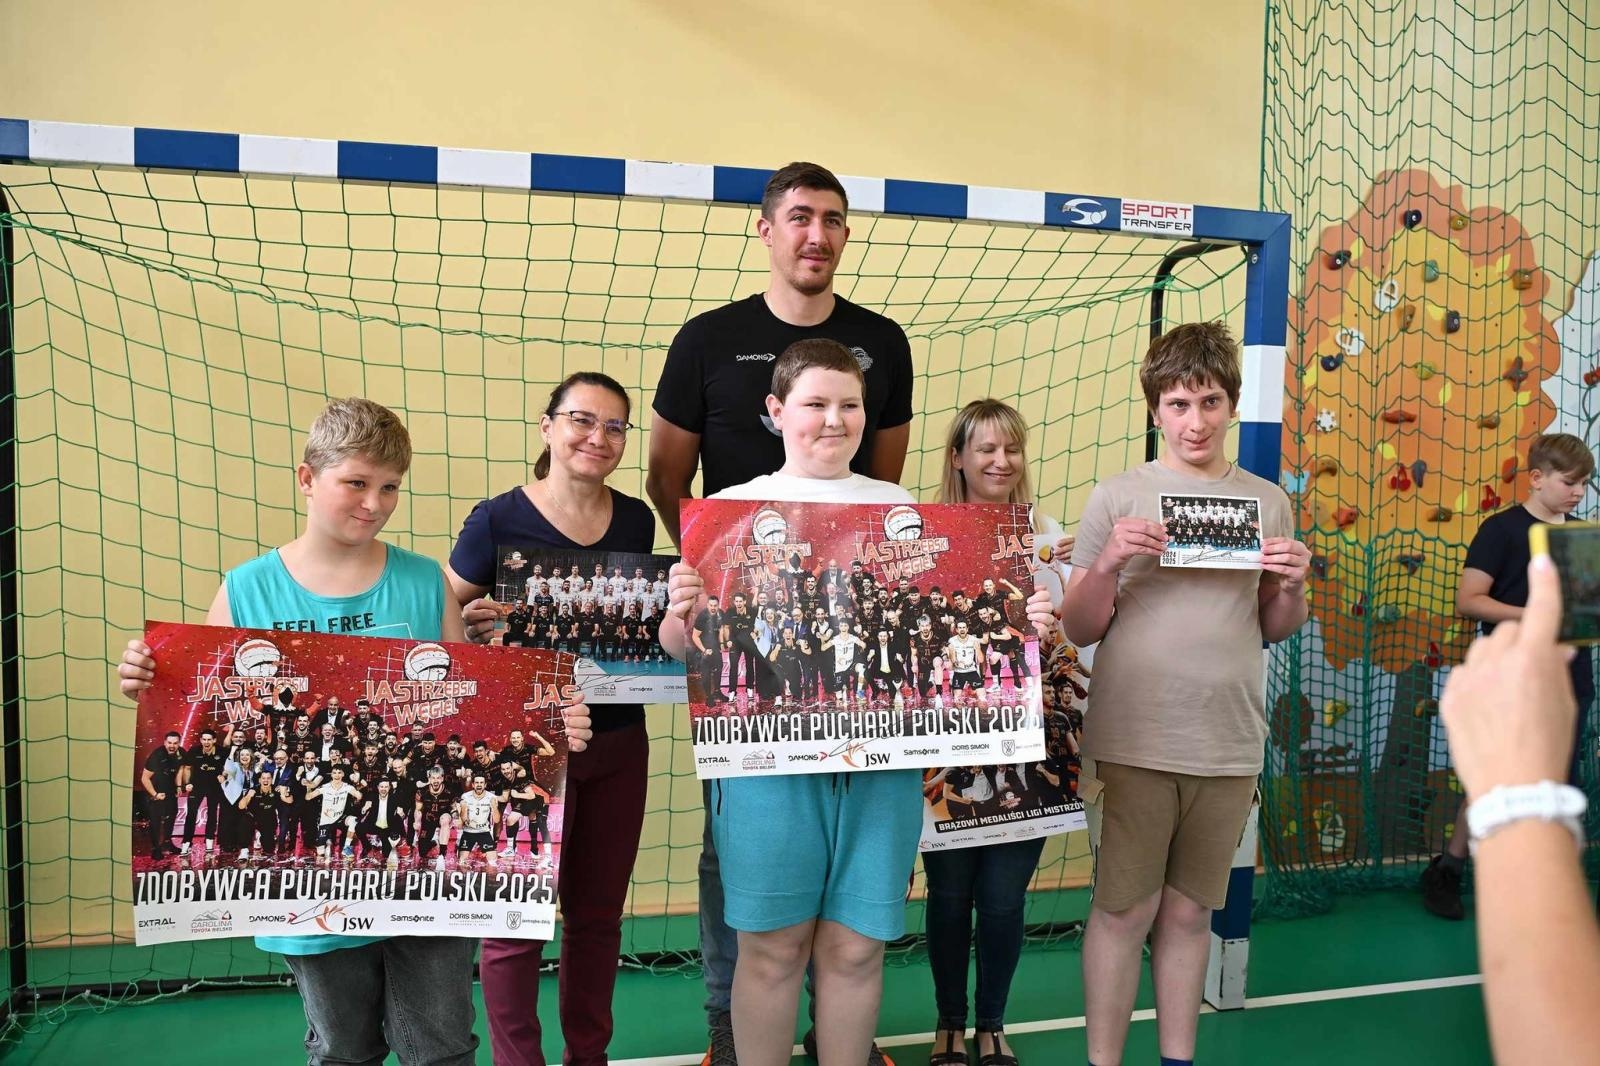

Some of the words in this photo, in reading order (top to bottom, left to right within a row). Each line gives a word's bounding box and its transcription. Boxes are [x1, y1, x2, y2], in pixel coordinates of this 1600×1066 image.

[1122, 203, 1192, 219] SPORT
[1122, 218, 1192, 231] TRANSFER
[736, 353, 769, 362] DAMONS
[328, 612, 376, 633] FREE
[694, 713, 802, 746] ZDOBYWCA
[810, 709, 904, 742] PUCHARU
[912, 707, 980, 736] POLSKI
[788, 754, 819, 762] DAMONS
[903, 747, 940, 756] Samsonite
[698, 756, 730, 764] EXTRAL
[865, 752, 891, 768] JSW
[938, 818, 979, 832] BRĄZOWI
[980, 810, 1025, 826] MEDALIŚCI
[1026, 807, 1042, 818] LIGI
[135, 868, 272, 906] ZDOBYWCA
[280, 868, 397, 901] PUCHARU
[405, 869, 487, 903] POLSKI
[495, 873, 554, 905] 2025
[138, 917, 176, 928] EXTRAL
[249, 914, 286, 923] DAMONS
[341, 916, 374, 933] JSW
[390, 913, 435, 923] Samsonite
